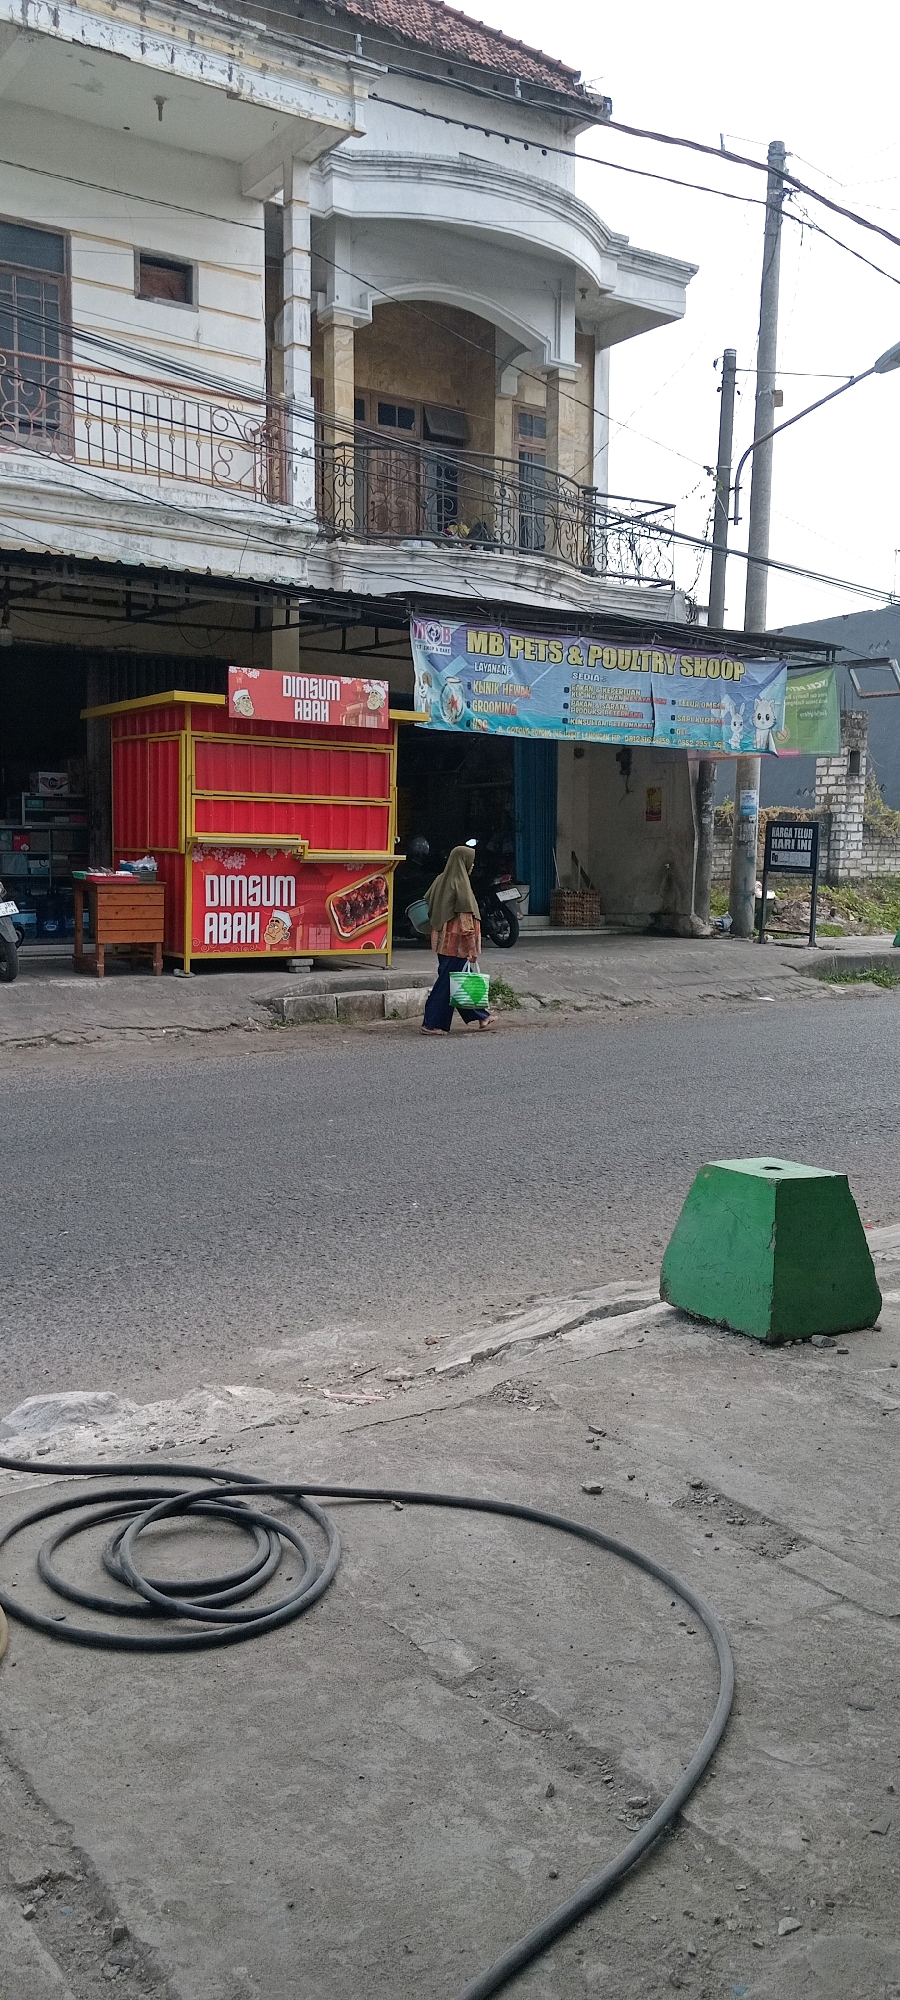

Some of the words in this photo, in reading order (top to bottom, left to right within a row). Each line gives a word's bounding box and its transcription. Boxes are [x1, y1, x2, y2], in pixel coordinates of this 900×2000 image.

[466, 629, 505, 658] MB
[508, 635, 563, 664] PETS
[566, 645, 584, 667] &
[587, 644, 677, 676] POULTRY
[680, 655, 746, 682] SHOOP
[282, 675, 341, 701] DIMSUM
[473, 680, 501, 696] KLINIK
[502, 683, 532, 699] HEWAN
[294, 699, 330, 722] ABAH
[472, 699, 518, 716] GROOMING
[771, 827, 793, 838] HARGA
[794, 828, 813, 839] TELUR
[771, 838, 795, 849] HARI
[797, 840, 812, 851] INI
[205, 875, 296, 907] DIMSUM
[204, 912, 260, 945] ABAH
